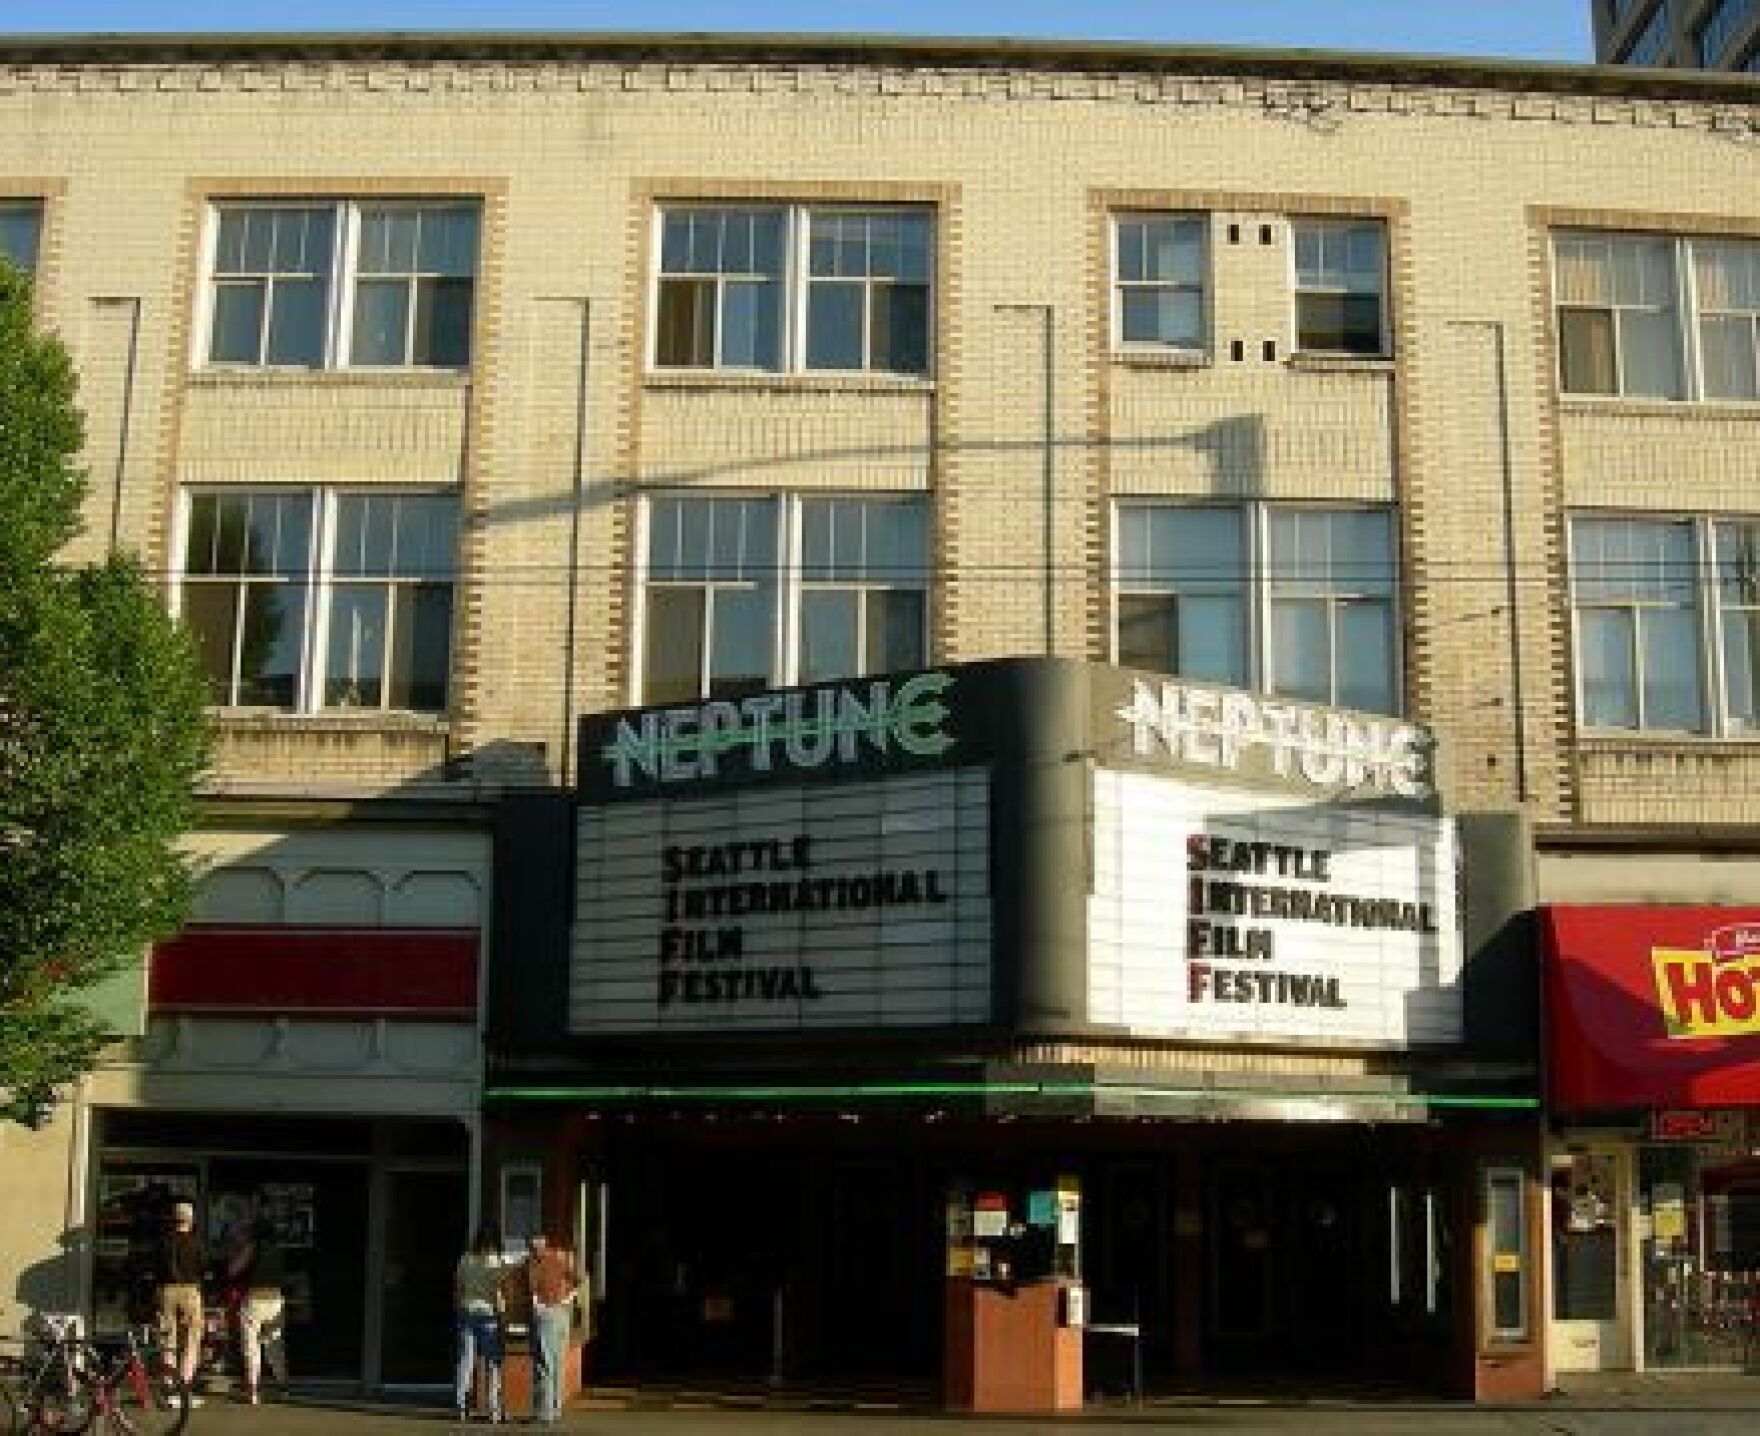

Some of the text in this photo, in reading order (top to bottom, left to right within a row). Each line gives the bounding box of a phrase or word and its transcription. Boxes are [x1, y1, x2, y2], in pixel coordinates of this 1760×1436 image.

[603, 673, 957, 787] NEPTUNE
[1114, 677, 1438, 798] NEPTUNE
[661, 834, 811, 880] SEATTLE
[1187, 834, 1331, 882] SEATTLE
[664, 869, 946, 922] INTERNATIONAL
[1188, 876, 1436, 931] INTERNATIONAL
[661, 927, 743, 964] FILM
[1187, 918, 1273, 960] FILM
[657, 966, 824, 1009] FESTIVAL
[1187, 964, 1347, 1007] FESTIVAL
[1664, 962, 1760, 1024] HO
